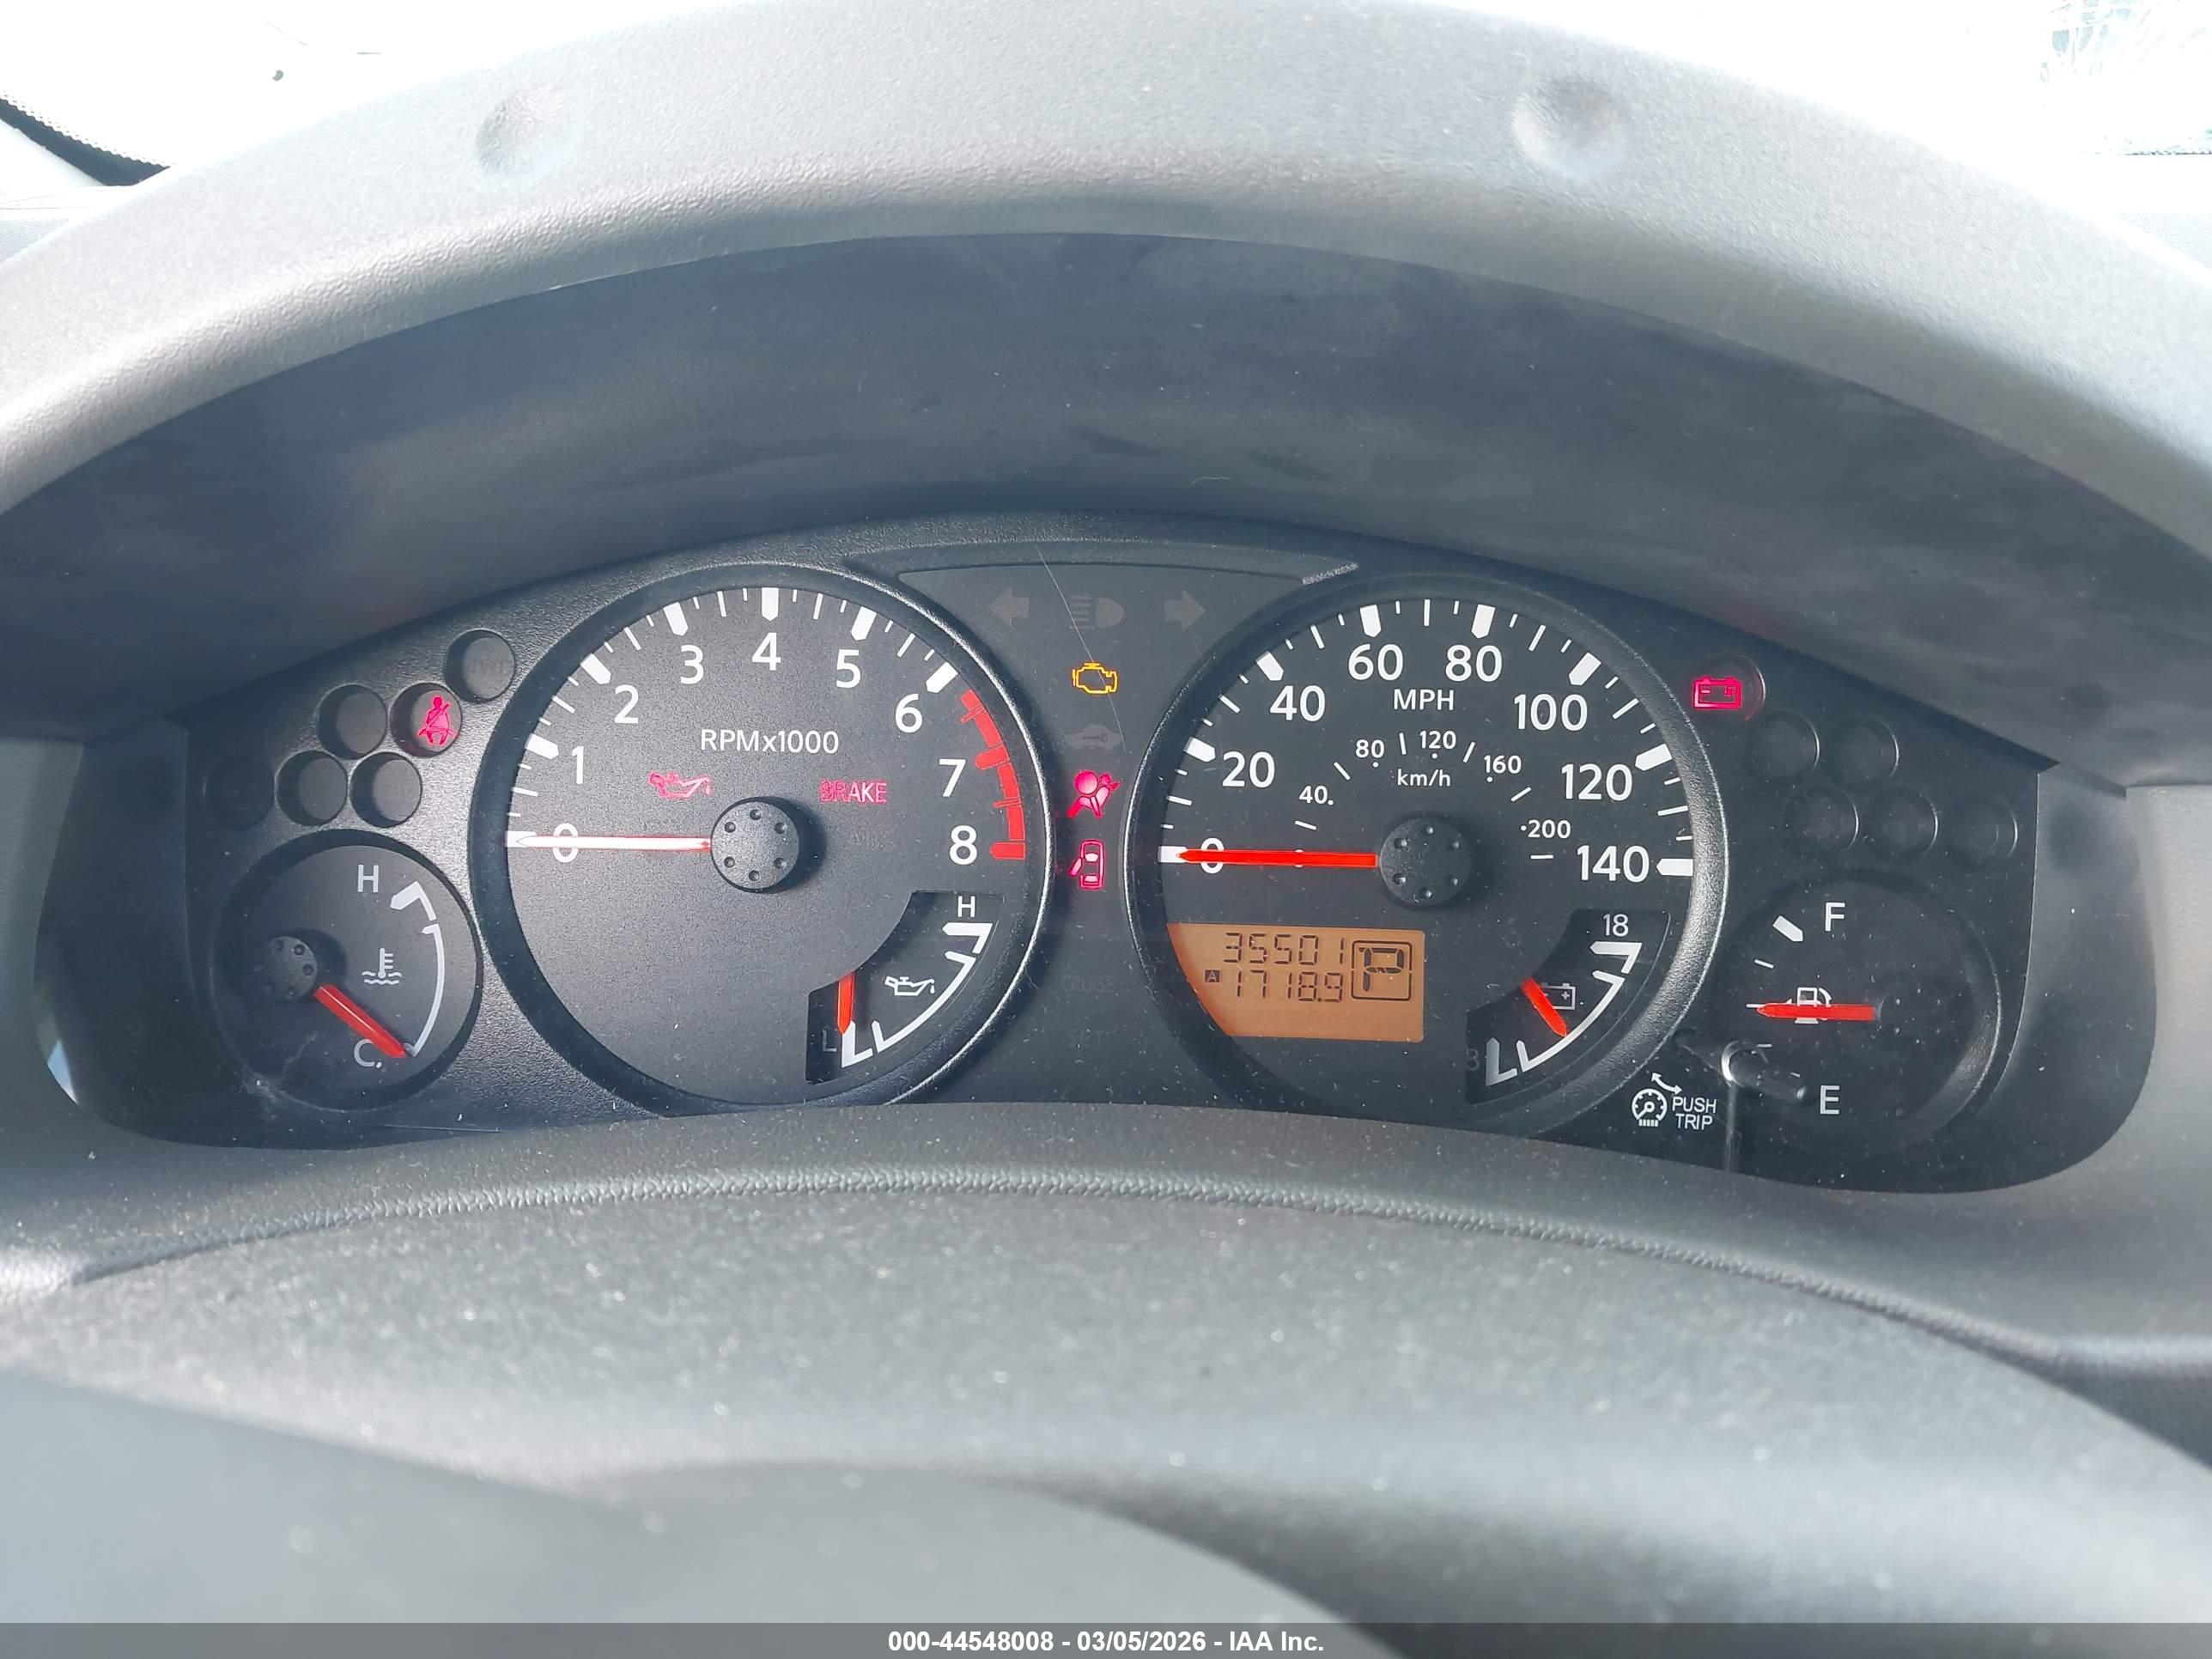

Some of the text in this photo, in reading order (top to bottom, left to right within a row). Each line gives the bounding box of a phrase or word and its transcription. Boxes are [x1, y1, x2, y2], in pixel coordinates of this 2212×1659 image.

[680, 645, 704, 684] 3
[751, 633, 781, 671] 4
[836, 648, 861, 689] 5
[1348, 643, 1403, 681] 60
[1445, 644, 1502, 682] 80
[610, 684, 639, 725] 2
[895, 694, 923, 732] 6
[1269, 685, 1326, 722] 40
[1394, 689, 1454, 711] MPH
[1515, 693, 1588, 731] 100
[700, 729, 840, 754] RPMx1000
[1355, 739, 1385, 758] 80
[1419, 730, 1456, 750] 120
[571, 746, 584, 784] 1
[939, 759, 966, 797] 7
[1222, 751, 1275, 788] 20
[1397, 769, 1450, 787] km/h
[1484, 755, 1522, 774] 160
[820, 780, 888, 804] BRAKE
[1298, 785, 1328, 805] 40
[1562, 763, 1632, 801] 120
[552, 823, 579, 863] 0
[949, 825, 978, 866] 8
[1528, 819, 1571, 839] 200
[1200, 837, 1224, 874] 0
[1577, 845, 1650, 883] 140
[357, 864, 380, 893] H
[957, 896, 975, 917] H
[1825, 902, 1845, 932] F
[1602, 914, 1629, 936] 18
[1224, 933, 1346, 965] 35501
[1237, 969, 1343, 1003] 1718.9
[1358, 947, 1405, 992] P
[353, 1038, 376, 1067] C
[822, 1029, 837, 1052] L
[1672, 1096, 1717, 1114] PUSH
[1820, 1085, 1840, 1115] E
[1674, 1113, 1713, 1131] TRIP
